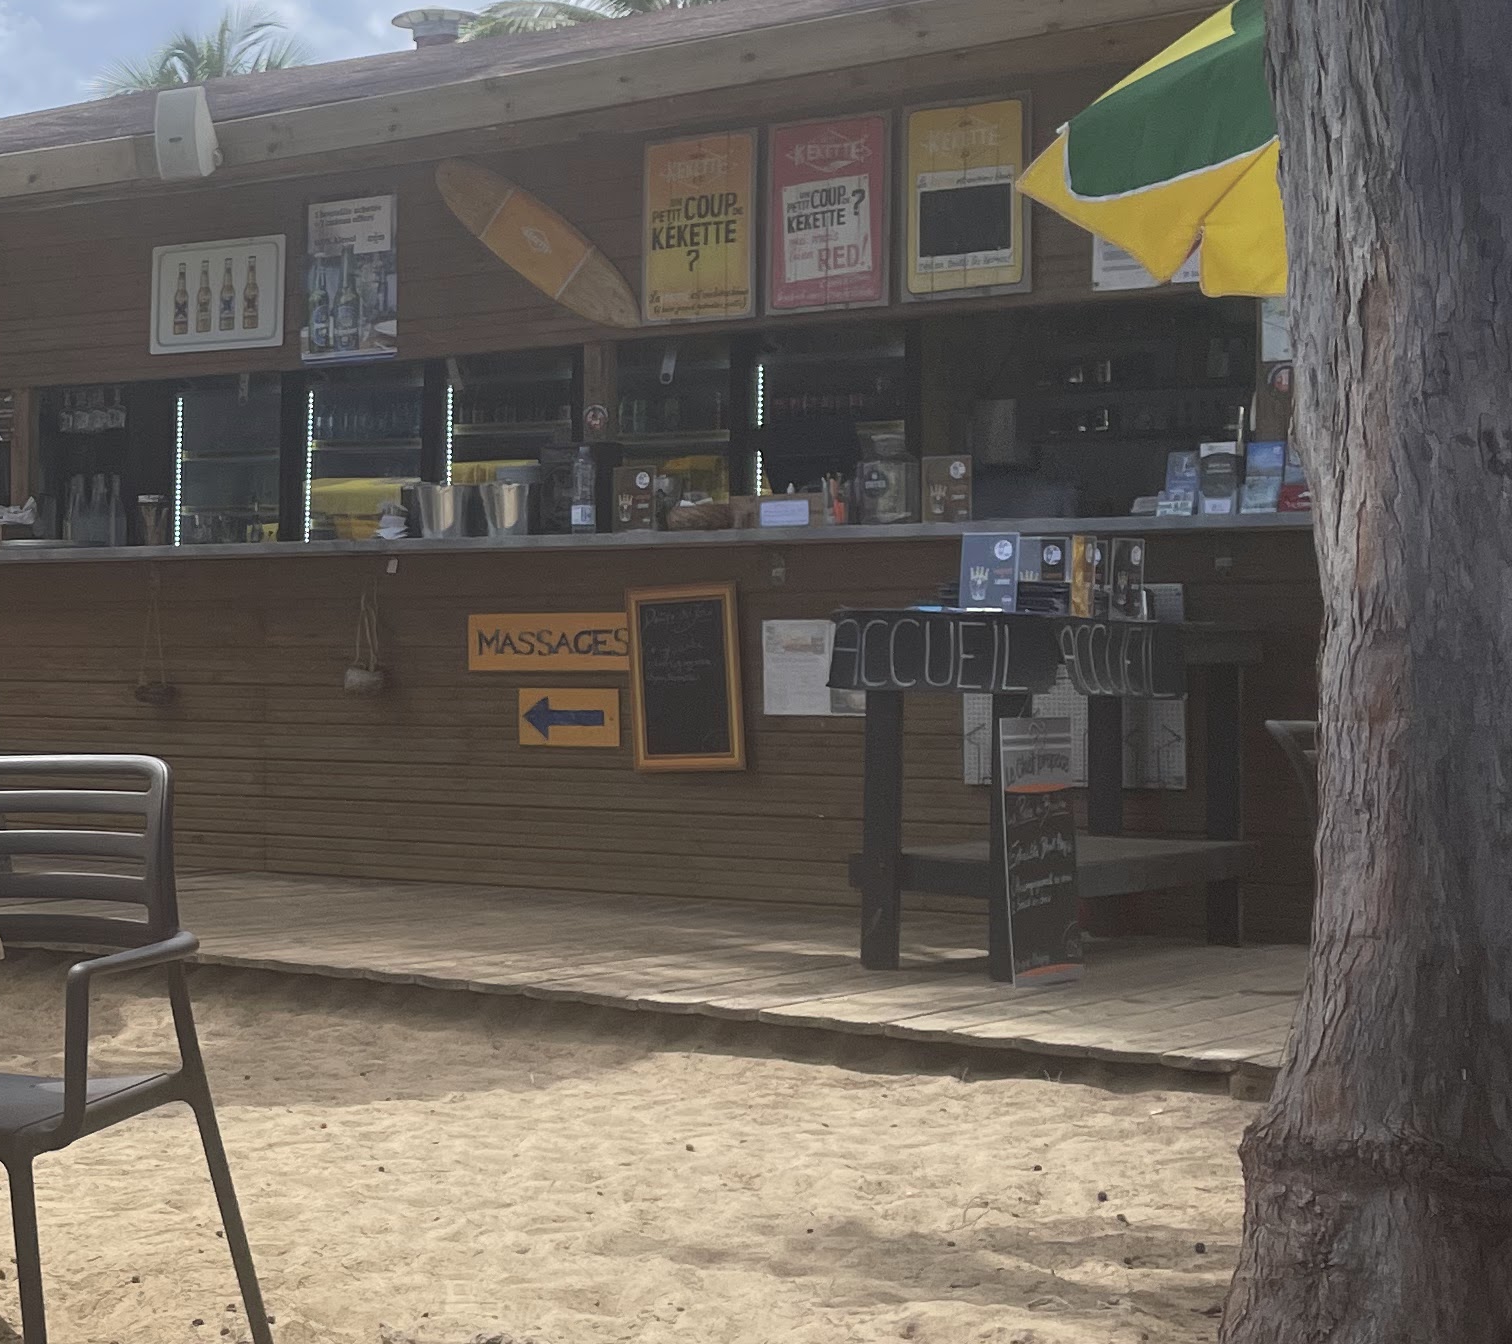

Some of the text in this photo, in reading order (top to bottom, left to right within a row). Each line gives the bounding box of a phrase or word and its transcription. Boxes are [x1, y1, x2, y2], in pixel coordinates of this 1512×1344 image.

[652, 208, 681, 224] PETIT
[683, 192, 738, 222] COUP
[787, 199, 810, 214] PETIT
[810, 185, 847, 209] COUP
[851, 188, 866, 216] ?
[651, 220, 737, 251] KÉKETTE
[686, 249, 700, 272] ?
[817, 235, 868, 272] RED!
[477, 627, 630, 656] MASSAGES
[832, 618, 1029, 692] ACCUEIL
[1059, 623, 1177, 697] ACCUEIL
